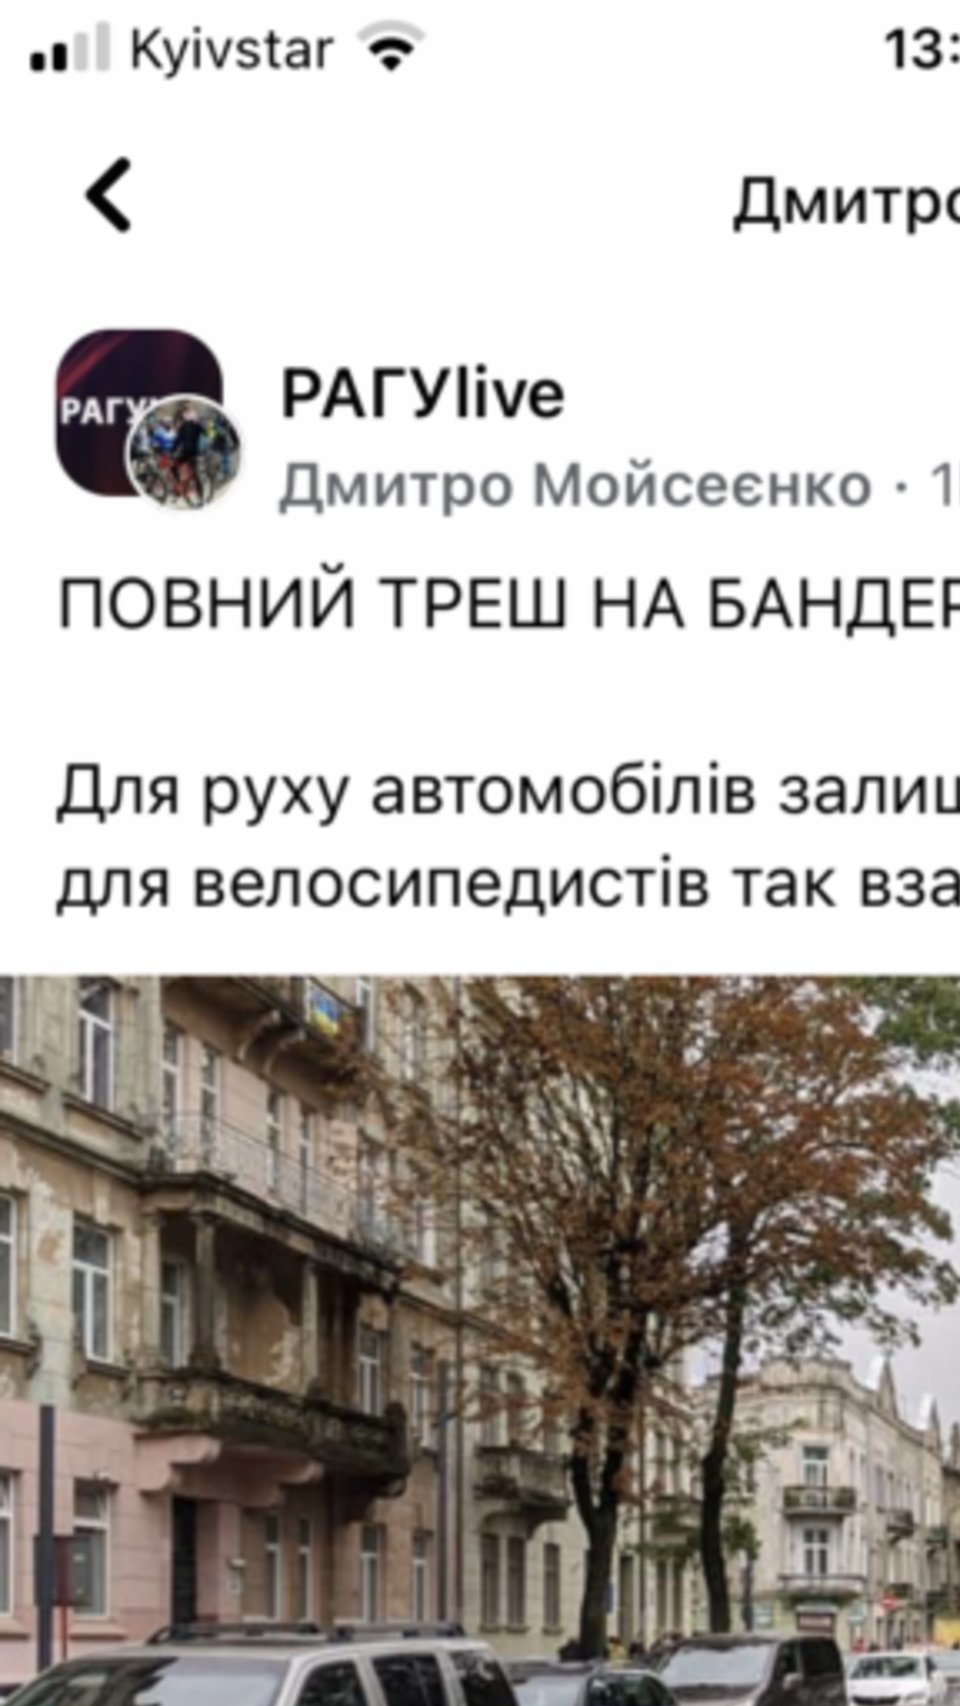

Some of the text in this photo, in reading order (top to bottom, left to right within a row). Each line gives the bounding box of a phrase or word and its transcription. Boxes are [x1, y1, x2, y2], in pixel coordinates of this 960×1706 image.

[129, 24, 335, 80] Kyivstar
[282, 362, 566, 420] РАГУlive
[277, 461, 514, 519] Дмитро
[533, 457, 873, 509] Мойсеєнко
[60, 561, 354, 631] ПОВНИЙ
[377, 576, 567, 630] ТРЕШ
[593, 576, 686, 630] НА
[54, 761, 179, 825] Для
[203, 774, 351, 828] руху
[371, 759, 756, 816] автомобілів
[54, 867, 169, 918] для
[194, 852, 710, 918] велосипедистів
[731, 866, 836, 909] так
